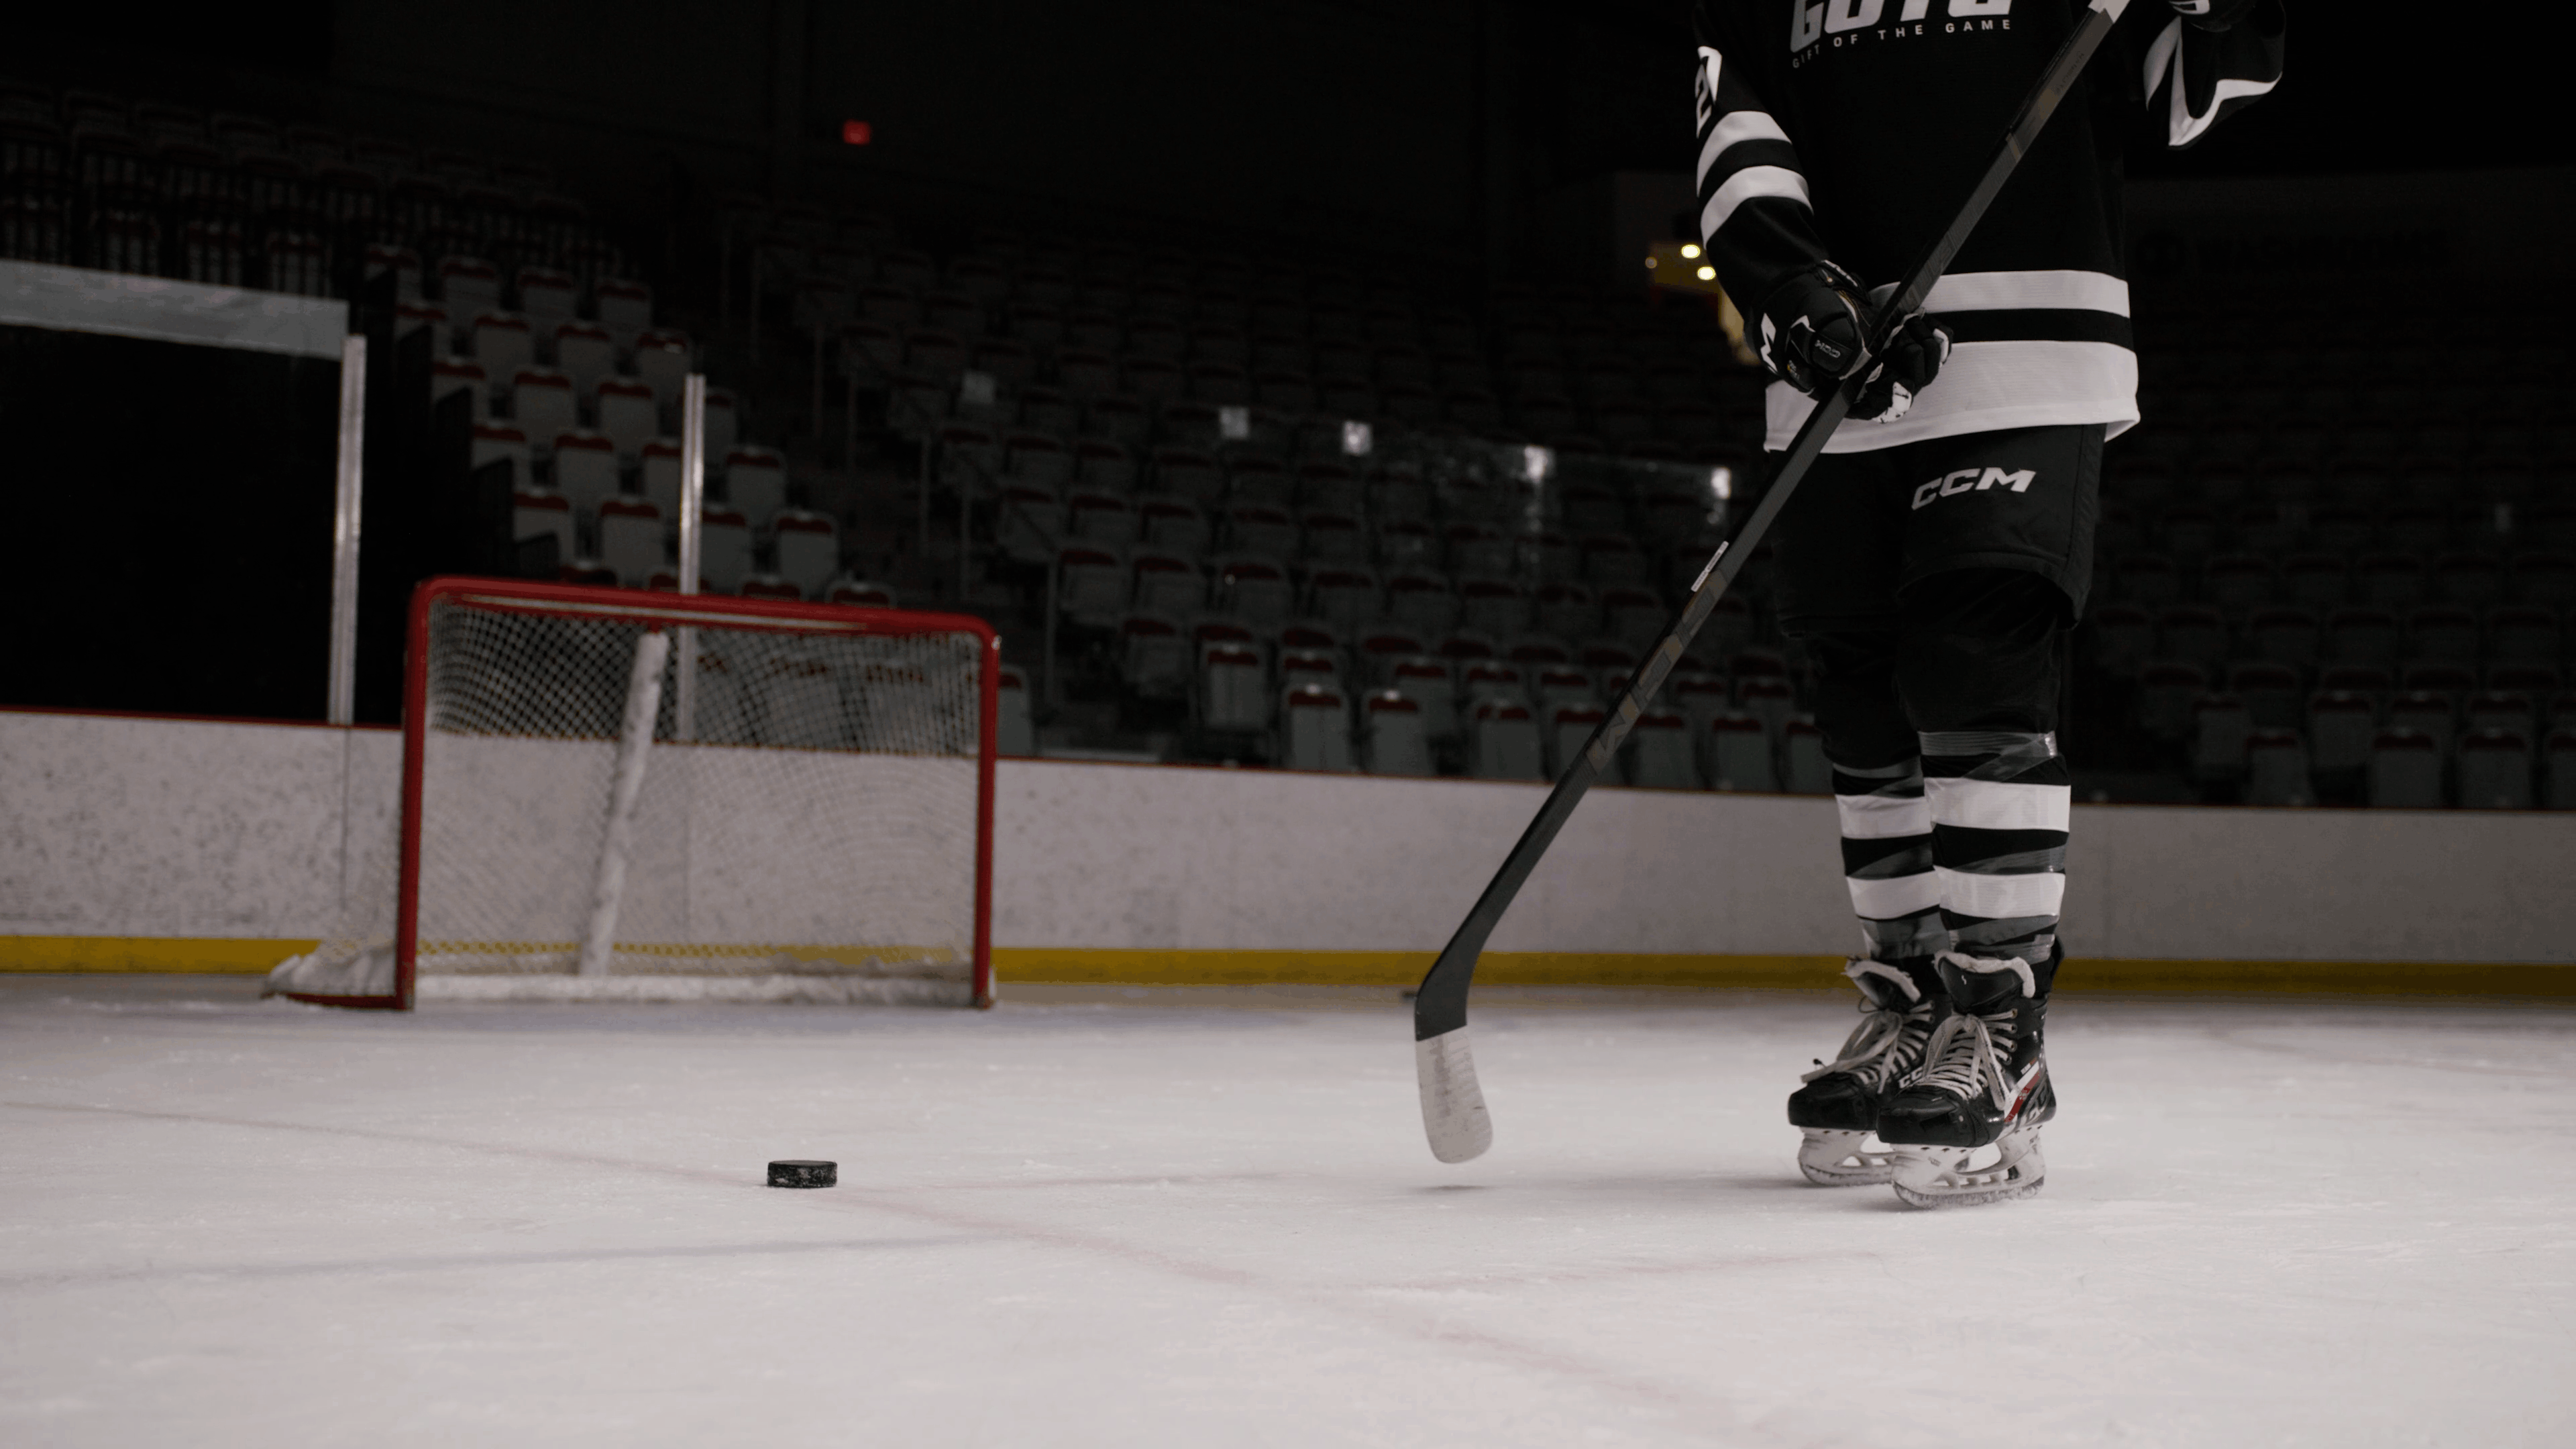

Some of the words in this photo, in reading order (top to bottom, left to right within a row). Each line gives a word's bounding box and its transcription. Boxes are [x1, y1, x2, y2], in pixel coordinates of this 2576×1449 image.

[1792, 44, 1820, 69] GIFT
[1833, 34, 1858, 48] OF
[1878, 24, 1923, 40] THE
[1945, 19, 2010, 34] GAME
[1814, 339, 1841, 359] CCM
[1911, 467, 2037, 511] CCM
[1585, 569, 1728, 771] CCM
